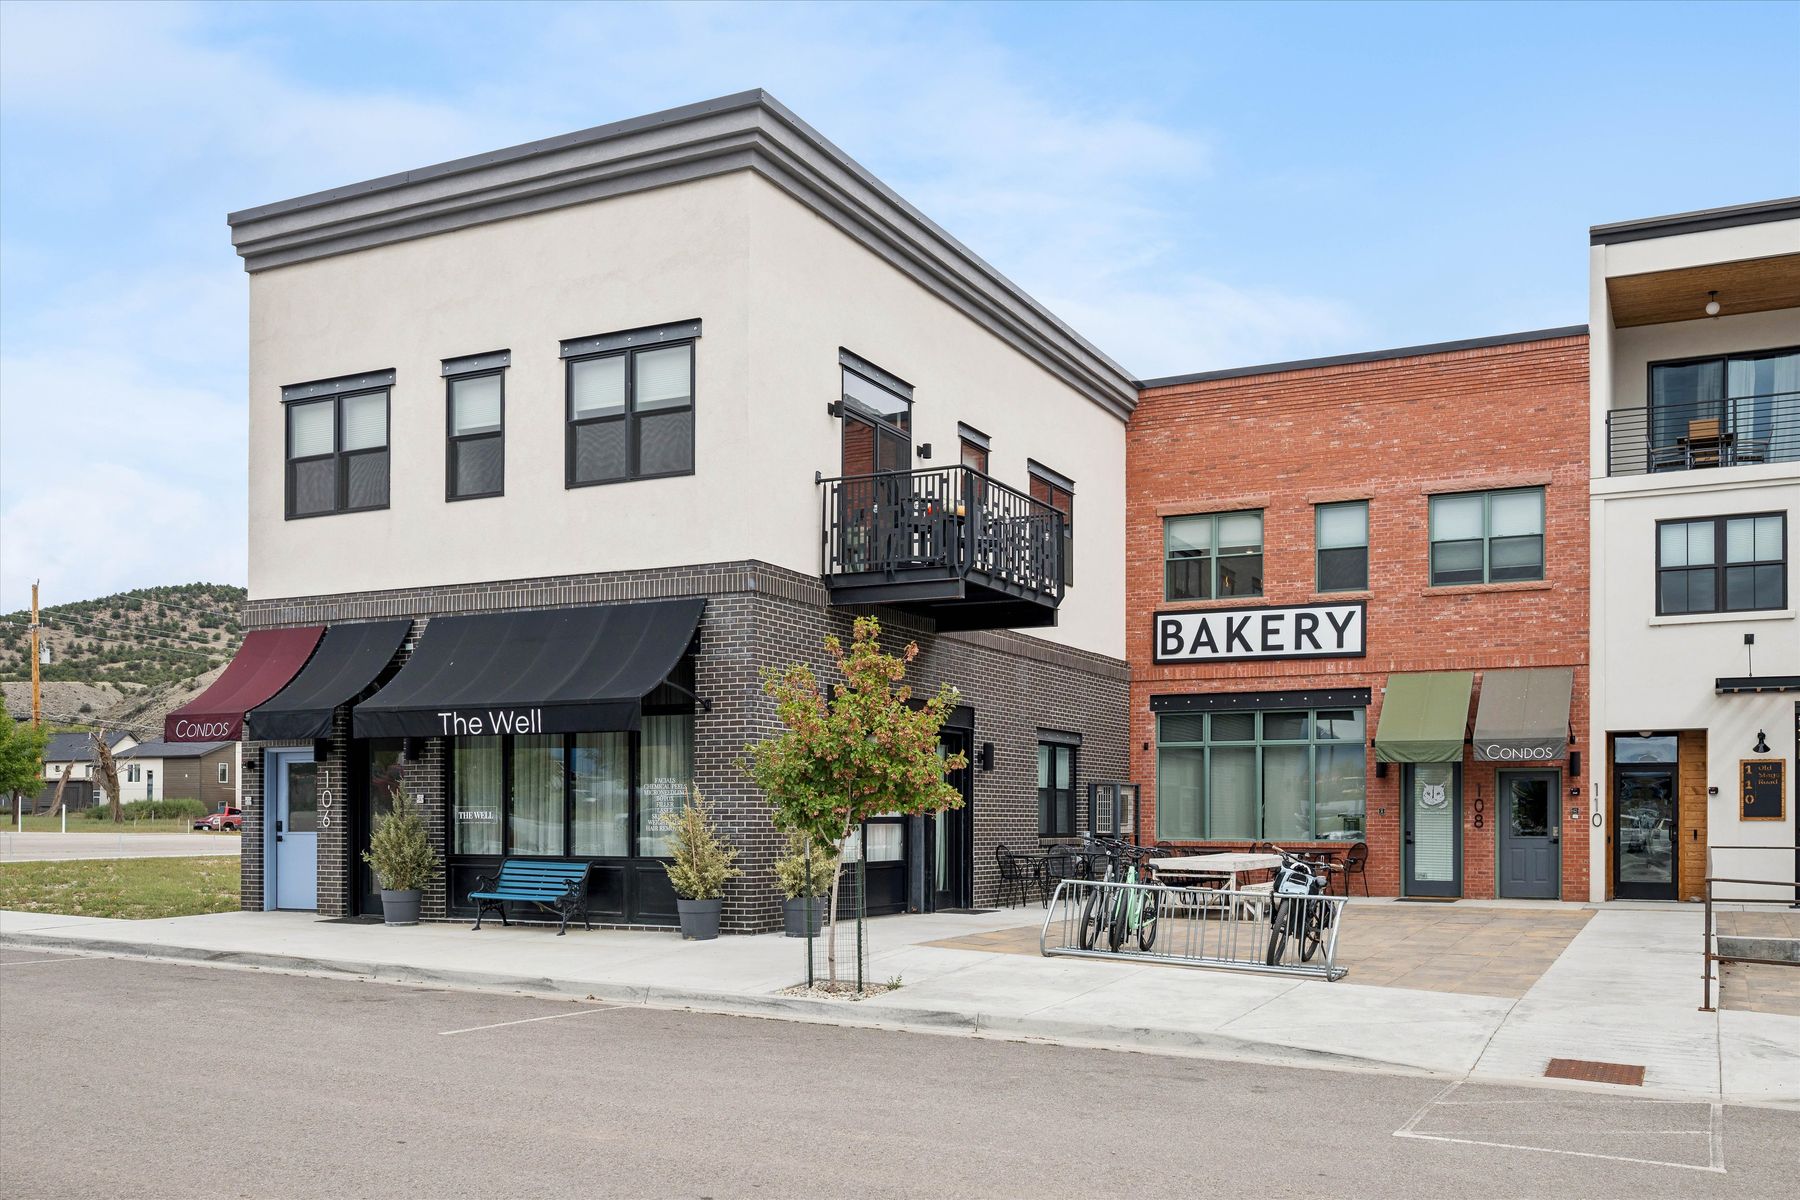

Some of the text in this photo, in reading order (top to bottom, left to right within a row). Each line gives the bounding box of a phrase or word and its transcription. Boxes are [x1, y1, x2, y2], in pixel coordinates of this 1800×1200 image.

[1161, 610, 1356, 656] BAKERY
[438, 709, 542, 736] The Well
[322, 770, 332, 827] 106
[458, 811, 494, 820] THE WELL
[1473, 783, 1484, 829] 108
[1592, 782, 1603, 828] 110
